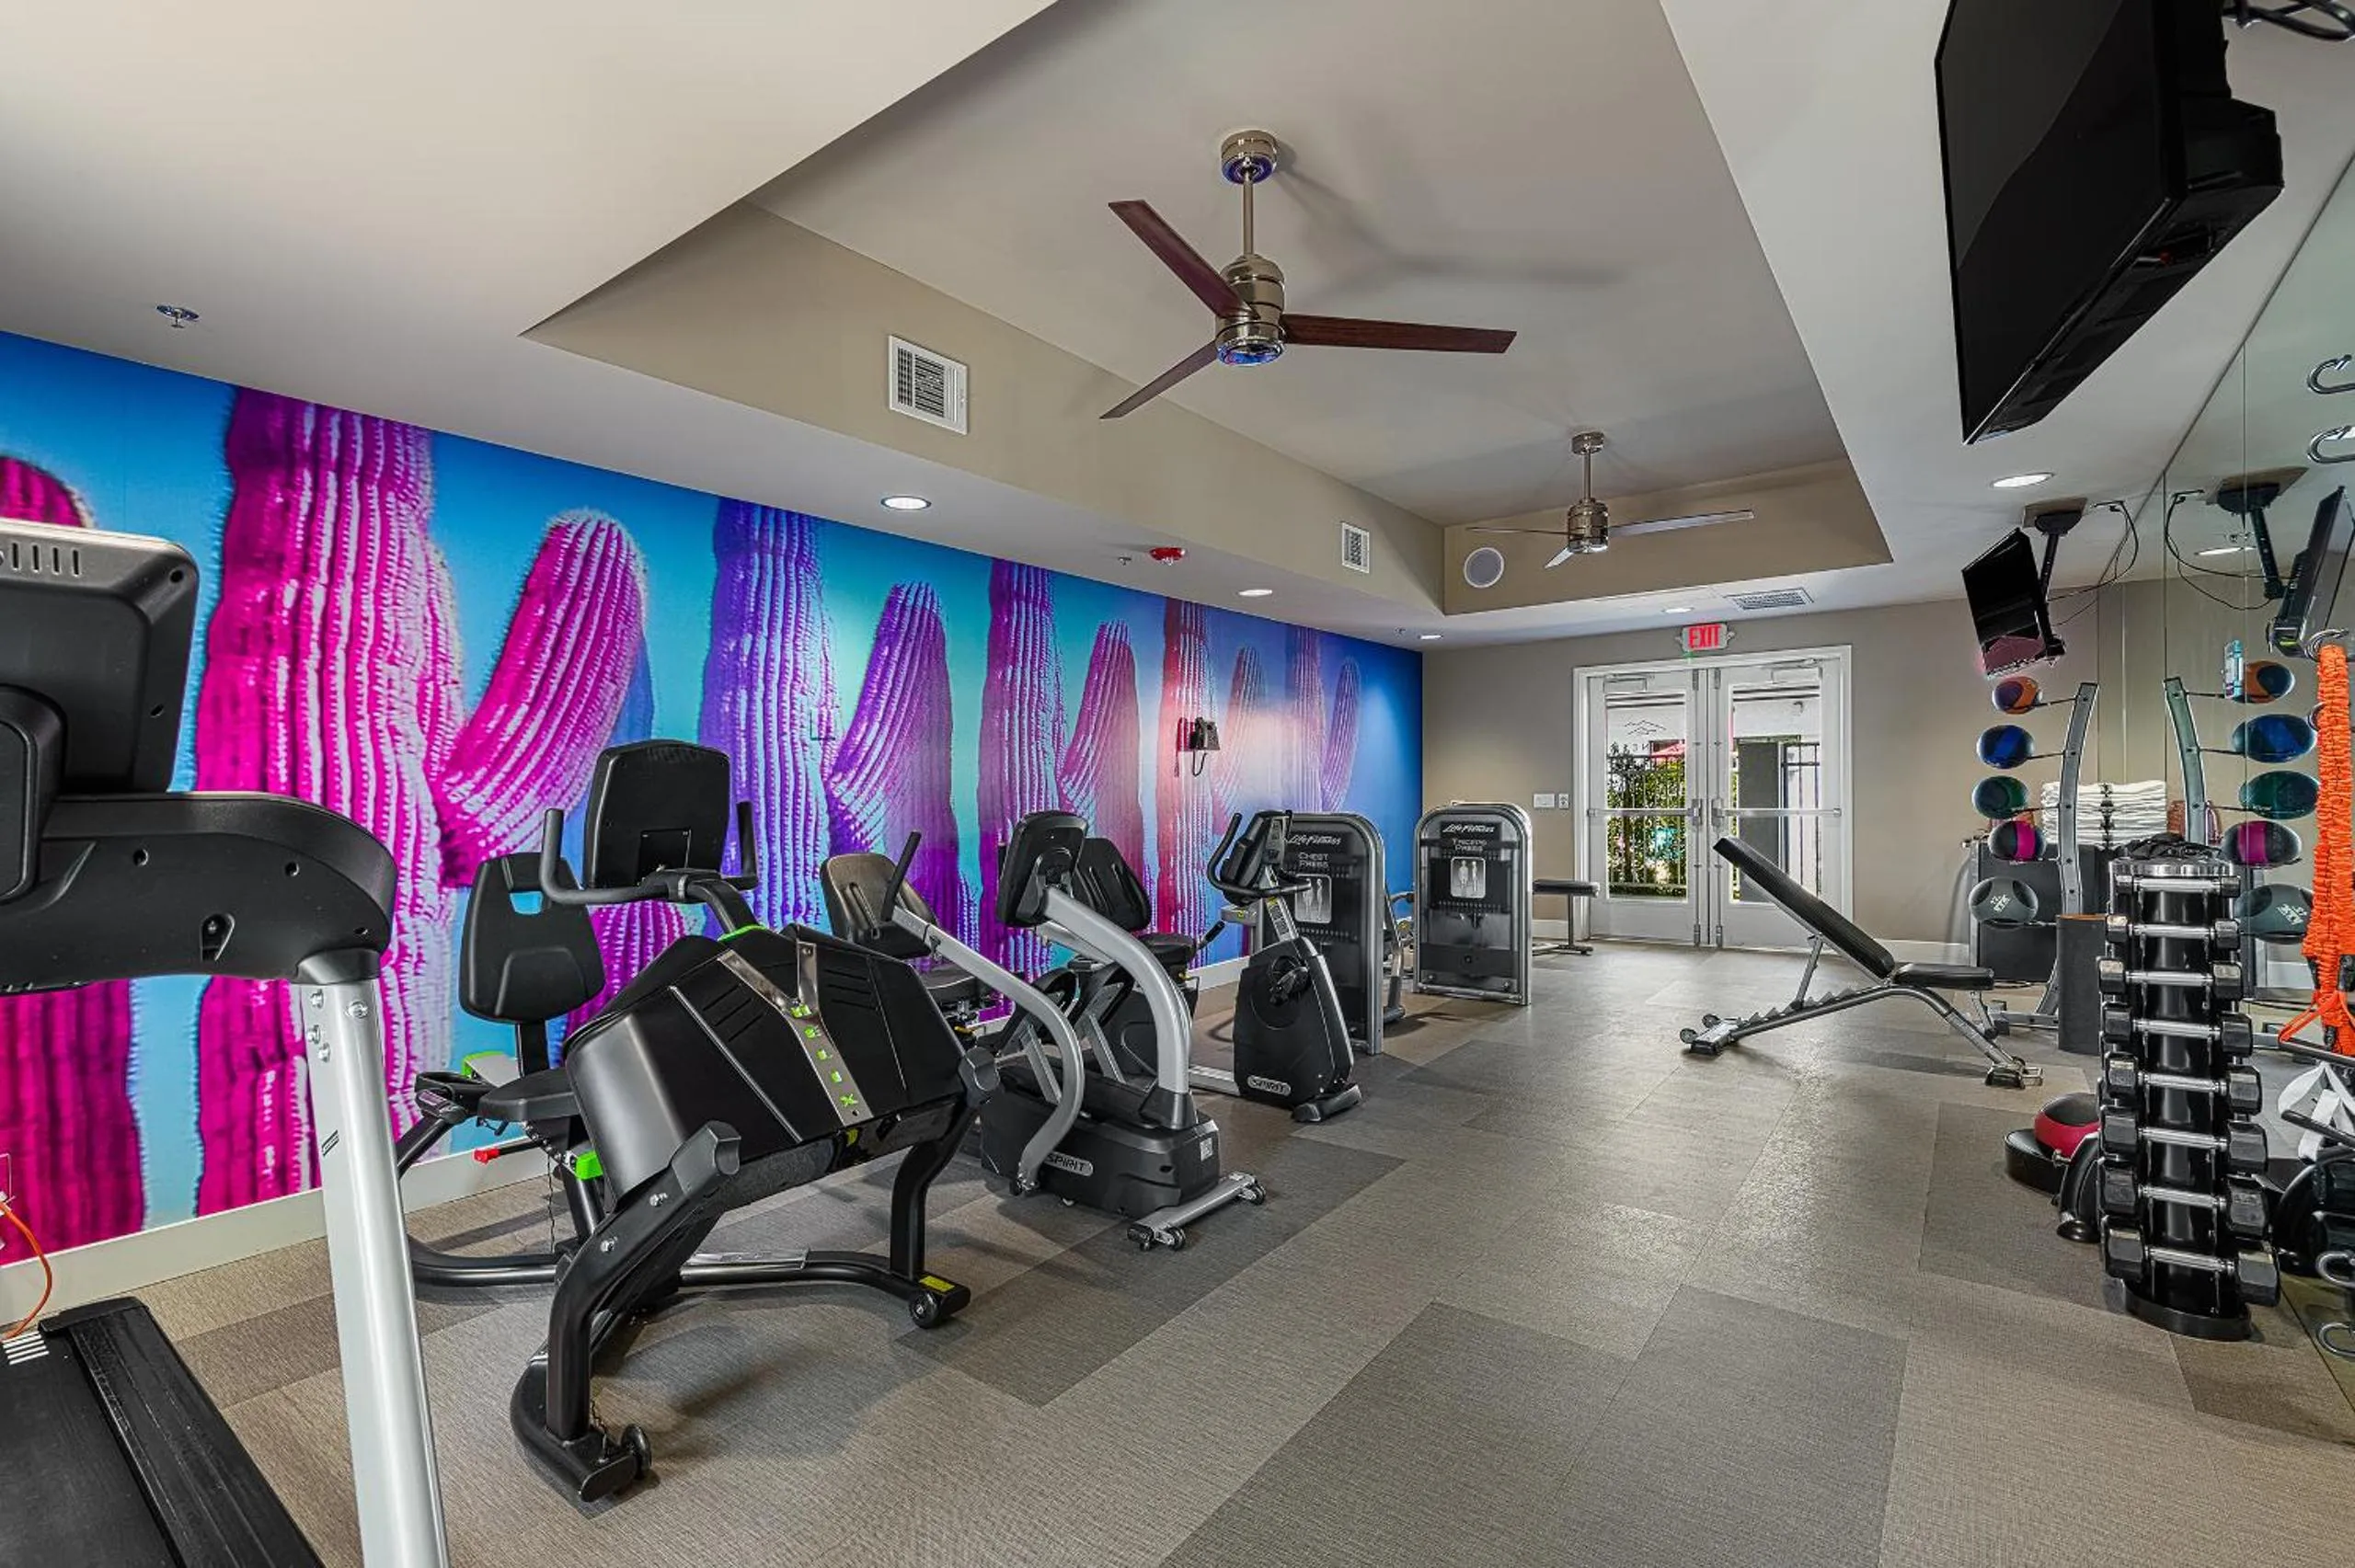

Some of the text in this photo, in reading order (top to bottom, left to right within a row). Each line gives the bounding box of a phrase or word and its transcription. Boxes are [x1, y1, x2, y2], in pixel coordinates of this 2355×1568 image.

[1688, 624, 1722, 648] EXIT
[1250, 1078, 1285, 1094] SPIRIT
[1047, 1152, 1084, 1172] SPIRIT
